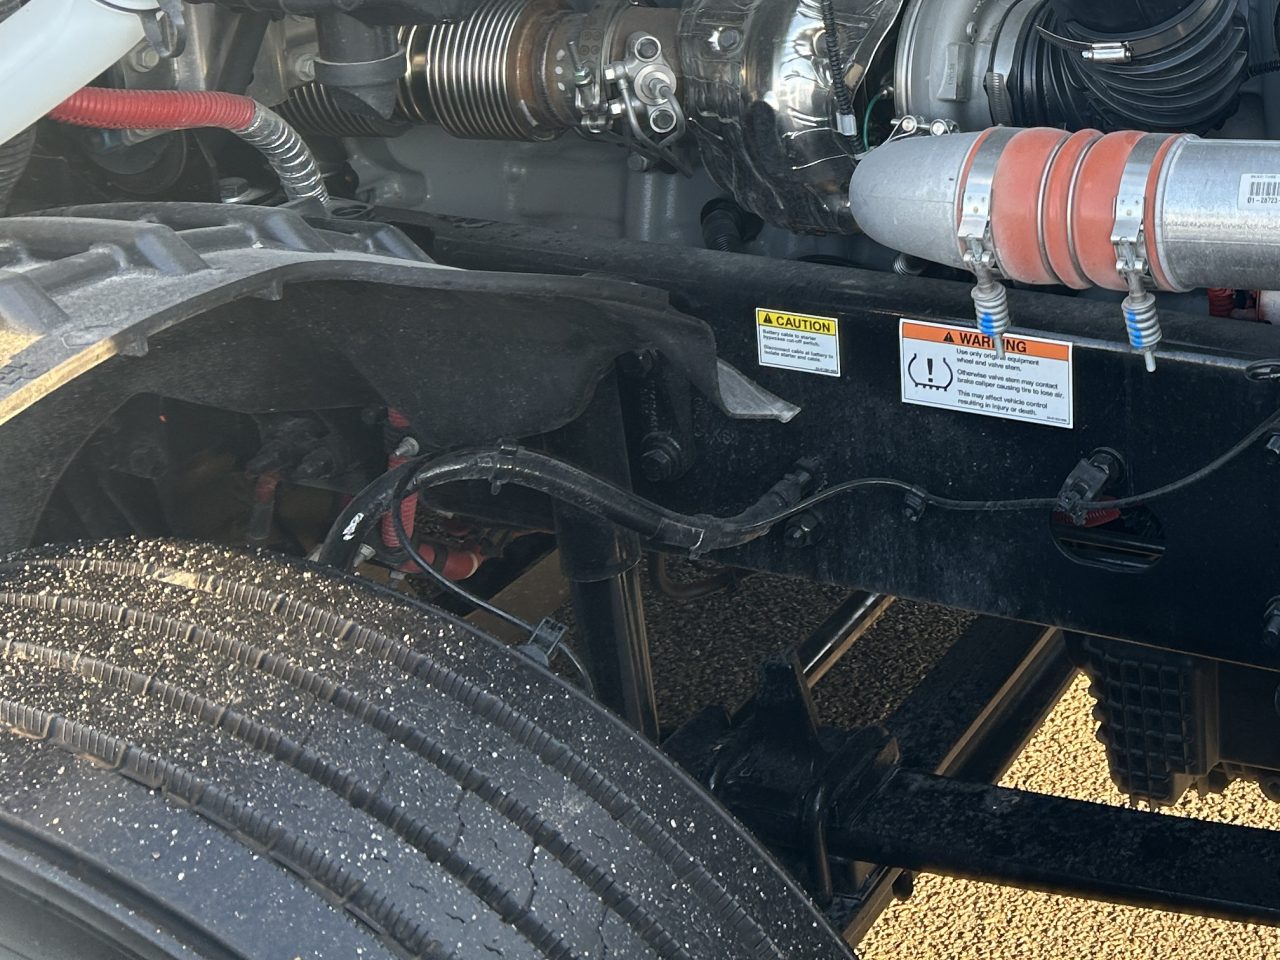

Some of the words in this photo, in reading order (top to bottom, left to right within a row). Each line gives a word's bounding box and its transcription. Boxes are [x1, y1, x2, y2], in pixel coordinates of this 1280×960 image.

[776, 316, 831, 333] CAUTION
[764, 344, 790, 353] Disconnect
[811, 351, 828, 359] battery
[969, 350, 982, 359] only
[1007, 356, 1040, 366] equipment
[957, 357, 974, 365] wheel
[957, 368, 987, 379] Otherwise
[1021, 378, 1034, 387] may
[1035, 381, 1058, 390] contact
[957, 376, 974, 384] brake
[975, 380, 996, 388] caliper
[997, 383, 1020, 393] causing
[958, 389, 970, 397] This
[971, 392, 984, 400] may
[985, 394, 1003, 402] affect
[1004, 396, 1025, 405] vehicle
[1026, 401, 1048, 409] control
[958, 399, 984, 408] resulting
[992, 403, 1009, 413] injury
[1018, 407, 1037, 416] death.
